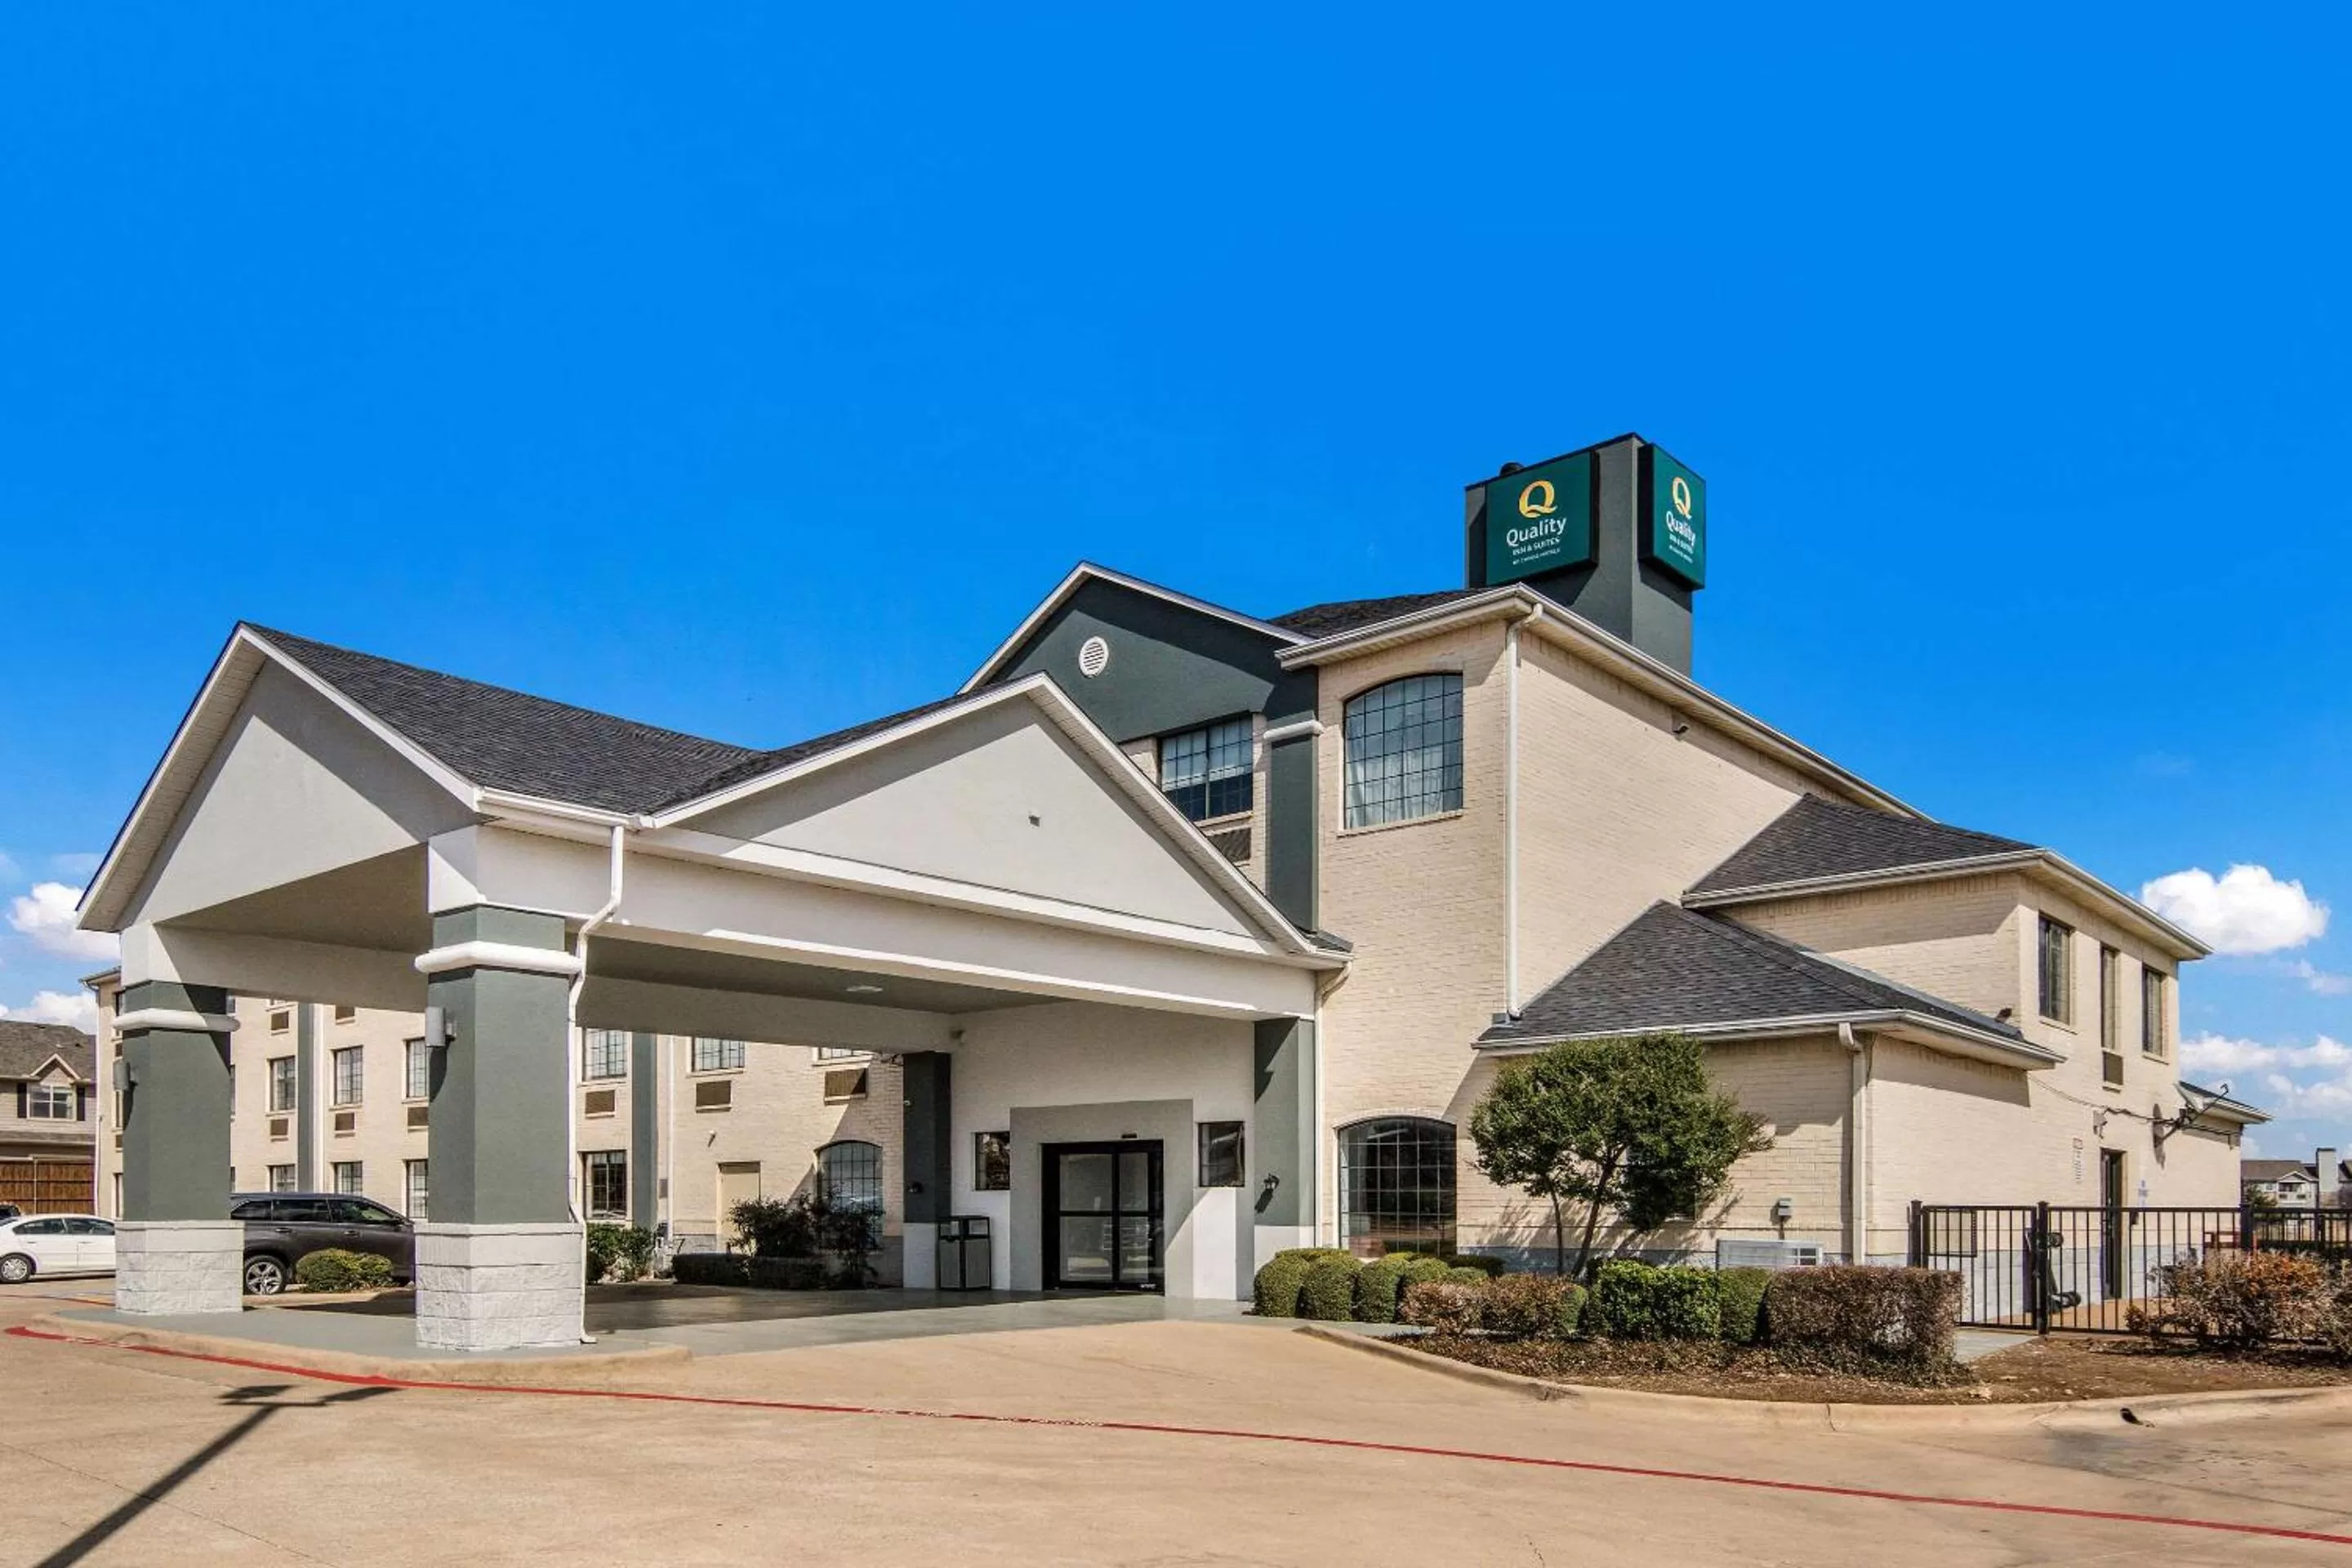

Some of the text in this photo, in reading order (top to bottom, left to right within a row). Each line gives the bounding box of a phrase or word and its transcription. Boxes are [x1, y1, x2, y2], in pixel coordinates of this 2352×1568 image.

[1519, 480, 1557, 518] Q
[1673, 476, 1692, 519] Q
[1506, 518, 1566, 547] Quality
[1666, 510, 1696, 547] Quality
